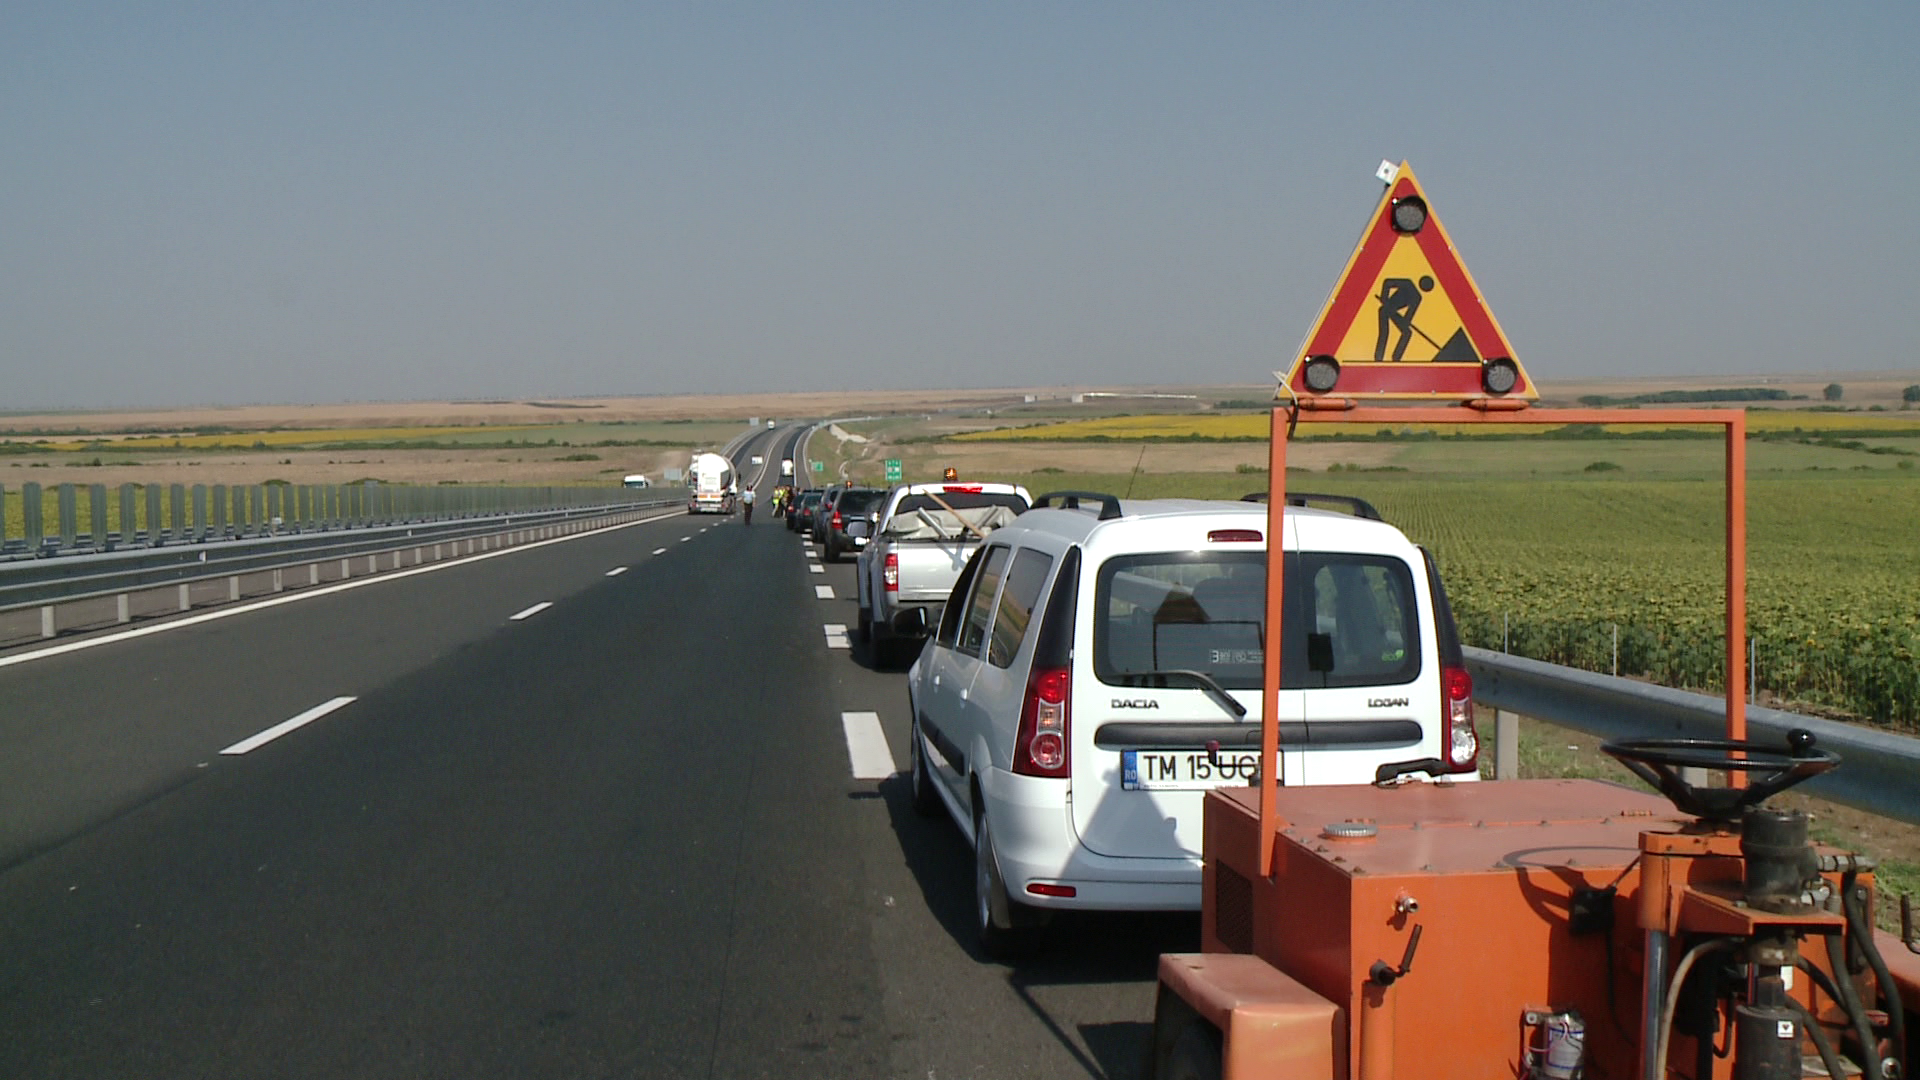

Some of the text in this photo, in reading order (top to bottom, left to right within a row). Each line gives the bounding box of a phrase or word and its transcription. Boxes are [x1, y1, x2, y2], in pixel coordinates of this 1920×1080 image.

[1111, 699, 1159, 710] DACIA
[1368, 698, 1409, 708] LOGAN
[1143, 755, 1176, 780] TM
[1187, 755, 1211, 780] 15
[1124, 769, 1137, 780] RO
